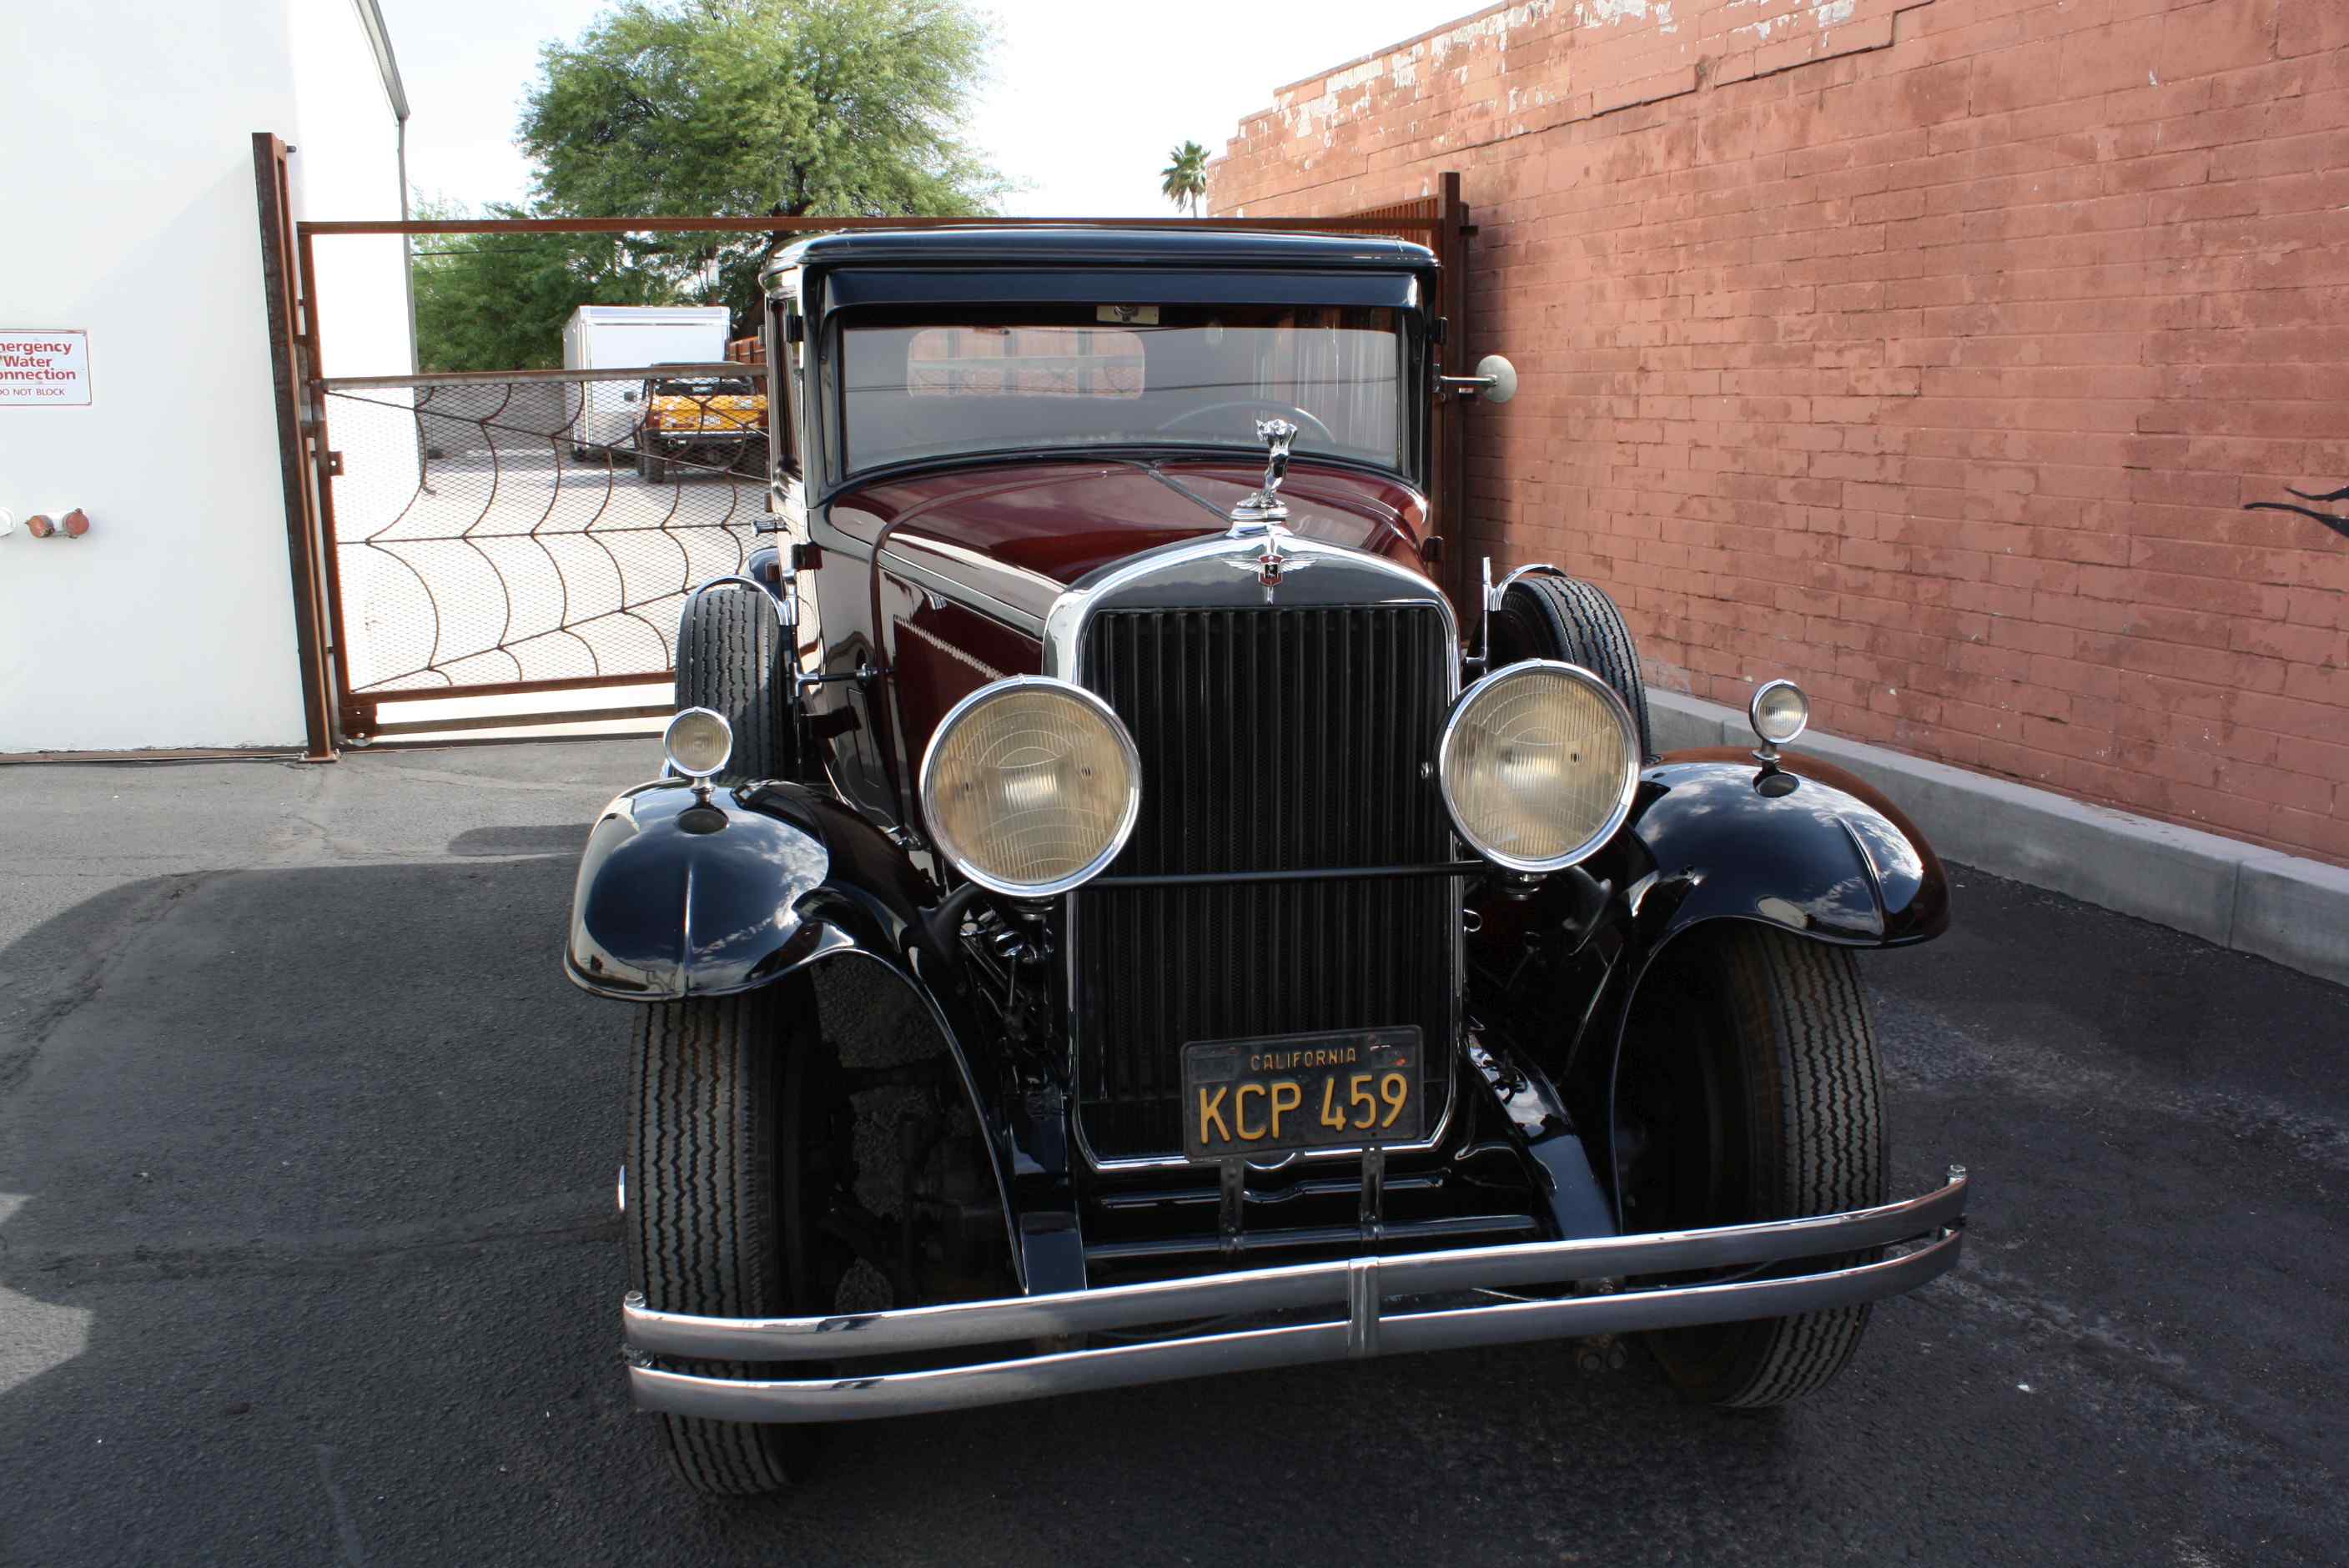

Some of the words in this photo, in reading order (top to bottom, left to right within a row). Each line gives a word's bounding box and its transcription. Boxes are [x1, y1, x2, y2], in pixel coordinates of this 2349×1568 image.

[13, 388, 34, 396] NOT
[36, 388, 66, 396] BLOCK
[1250, 1047, 1356, 1071] CALIFORNIA
[1199, 1082, 1302, 1144] KCP
[1320, 1073, 1408, 1132] 459
